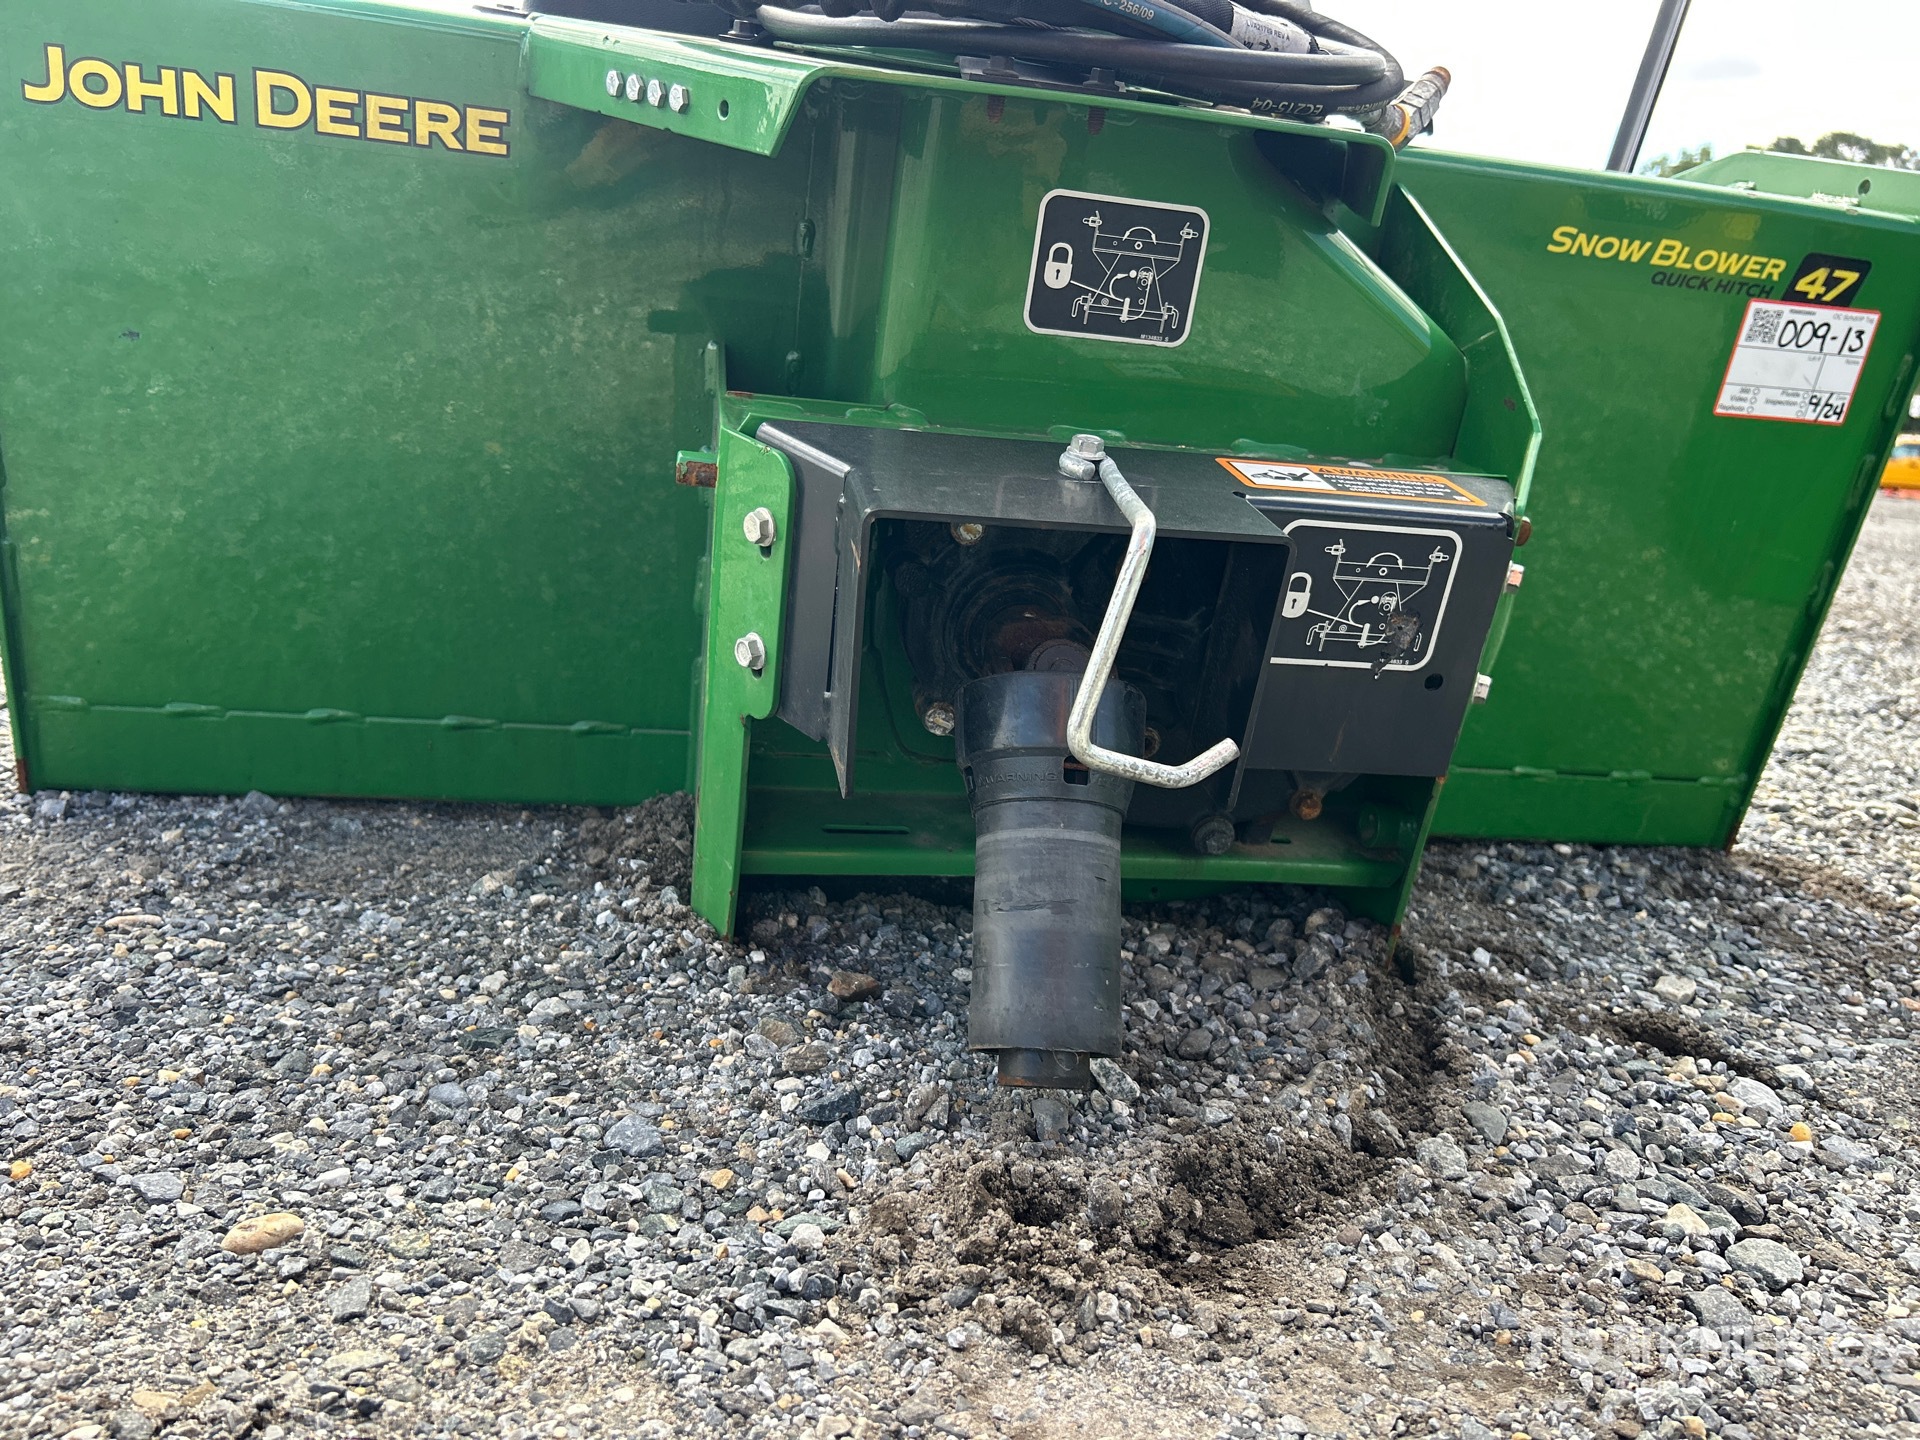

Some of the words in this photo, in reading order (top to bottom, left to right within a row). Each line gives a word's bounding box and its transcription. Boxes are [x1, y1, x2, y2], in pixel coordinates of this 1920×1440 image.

[22, 42, 238, 125] JOHN
[252, 66, 511, 158] DEERE
[1546, 226, 1652, 262] SNOW
[1650, 238, 1787, 281] BLOWER
[1793, 267, 1860, 302] 47
[1651, 271, 1713, 291] QUICK
[1714, 279, 1775, 298] HITCH
[1778, 319, 1866, 355] 009-13
[1332, 468, 1439, 482] WARNING
